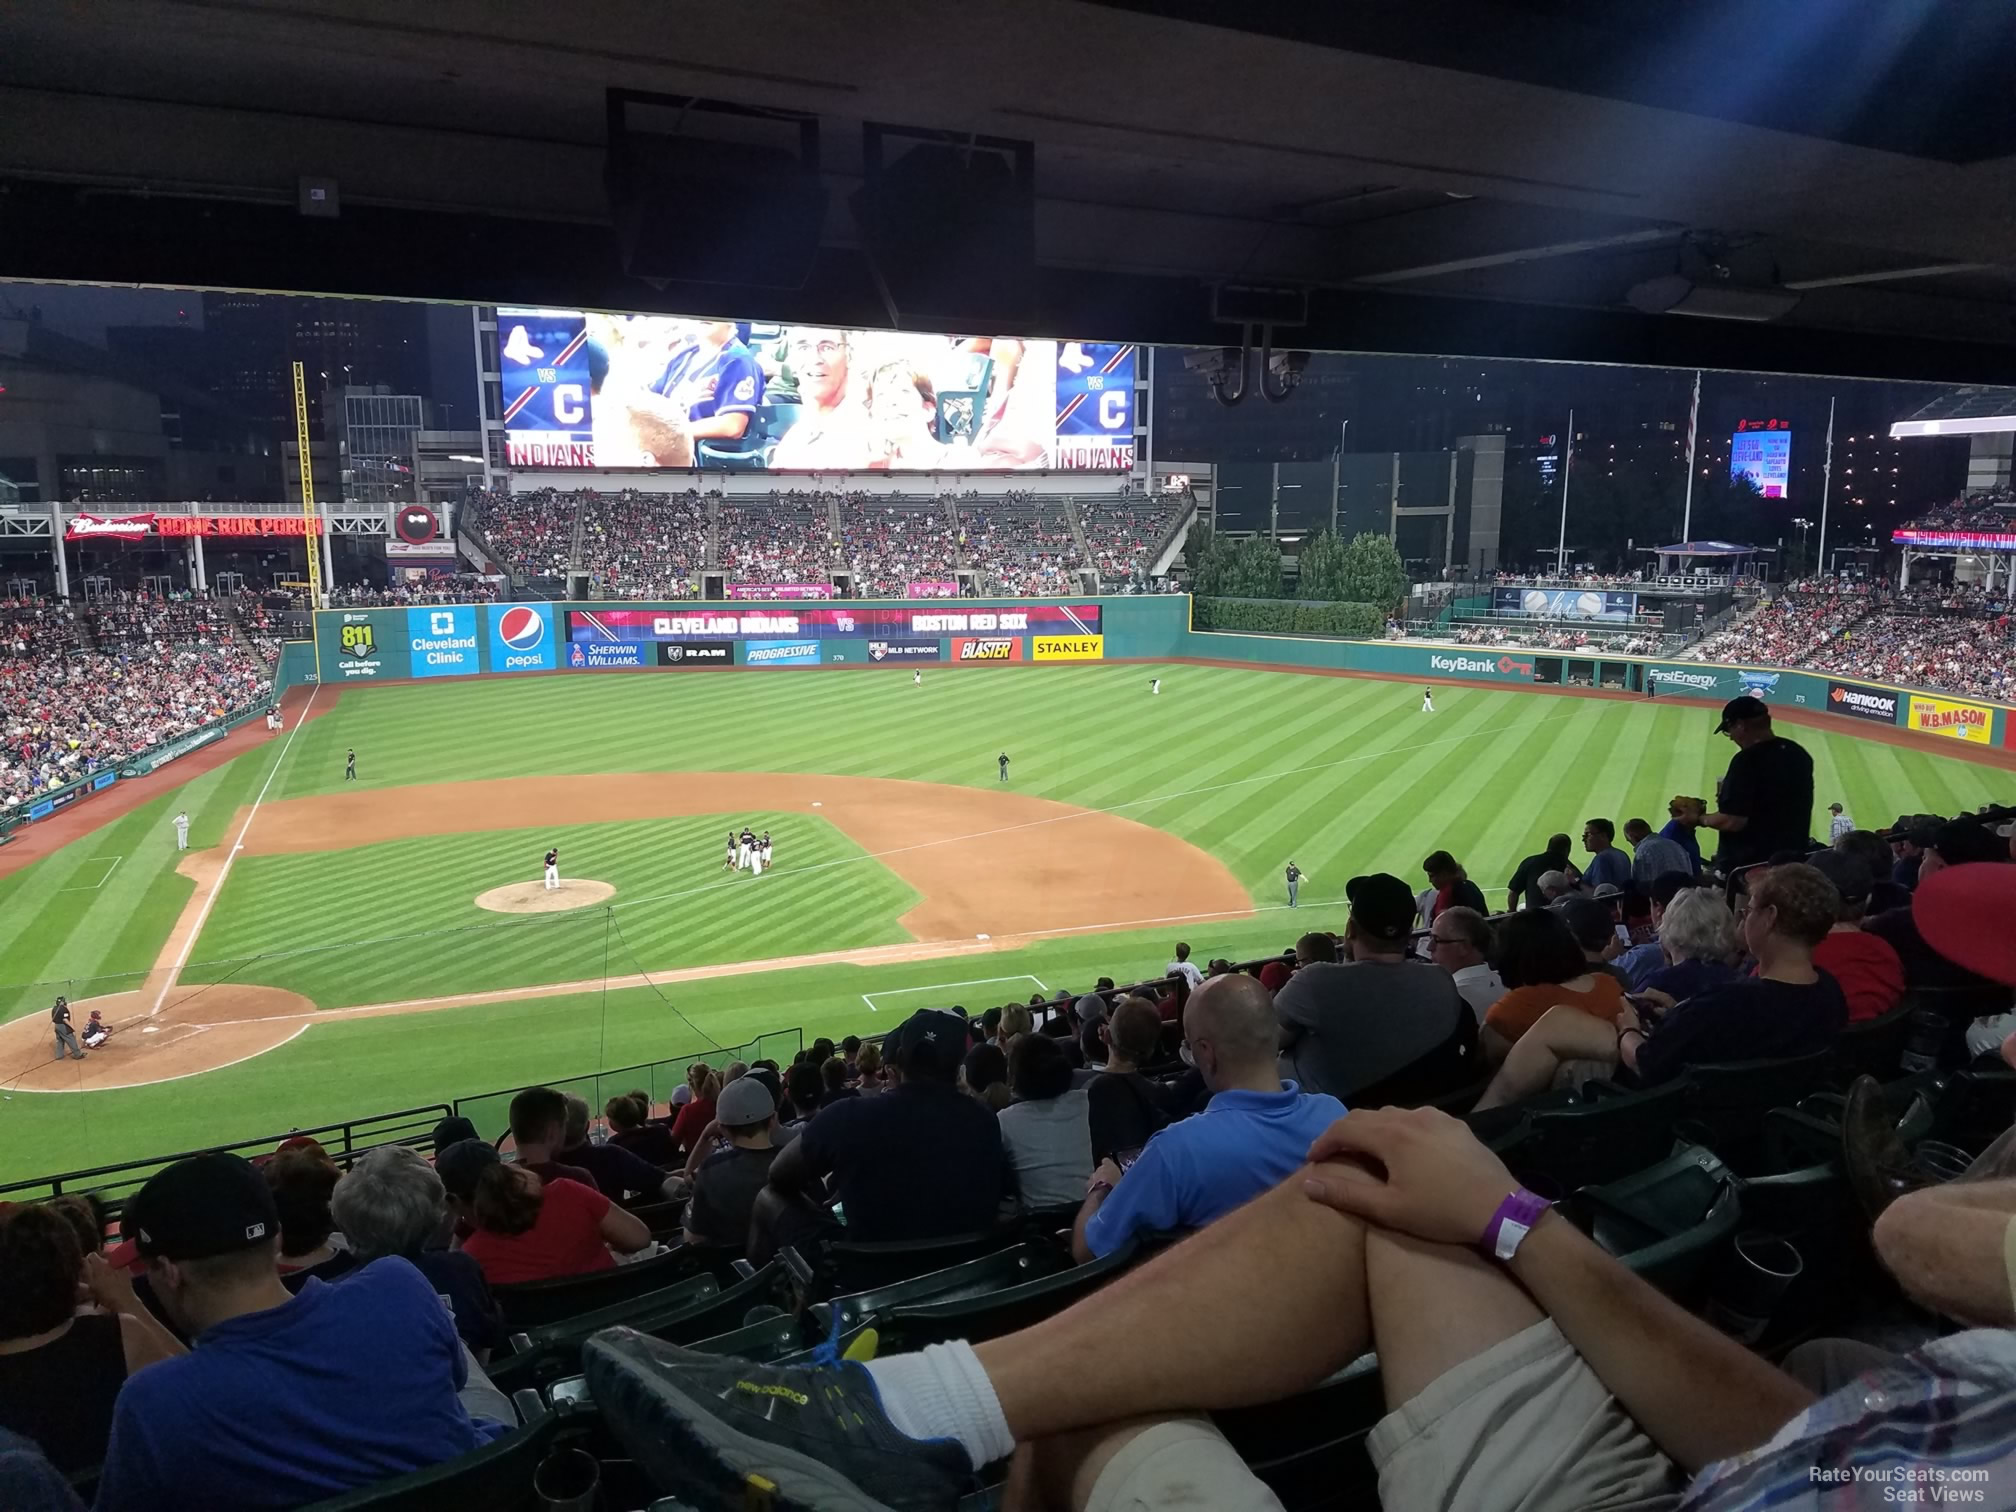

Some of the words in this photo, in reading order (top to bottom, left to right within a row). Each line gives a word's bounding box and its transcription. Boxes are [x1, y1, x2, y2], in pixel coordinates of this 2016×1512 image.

[537, 368, 557, 383] VS
[1087, 376, 1104, 390] VS
[553, 384, 584, 424] C
[1099, 391, 1125, 428] C
[508, 442, 595, 466] INDIANS
[1057, 447, 1133, 469] INDIANS
[70, 519, 149, 533] Budweiser
[158, 518, 212, 536] HOME
[217, 518, 257, 535] RUN
[654, 617, 738, 635] CLEVELAND
[740, 617, 799, 633] INDIANS
[837, 617, 855, 632] VS
[912, 615, 967, 632] BOSTON
[969, 615, 997, 631] RED
[999, 614, 1029, 630] SOX
[342, 625, 373, 647] 811
[412, 636, 476, 651] Cleveland
[588, 644, 637, 655] SHERWIN
[685, 649, 726, 657] RAM
[747, 645, 817, 661] PROGRESSIVE
[904, 646, 938, 654] NETWORK
[1037, 642, 1098, 654] STANLEY
[355, 660, 381, 668] before
[427, 652, 464, 665] Clinic
[506, 653, 543, 668] pepsi
[1431, 655, 1494, 673] KeyBank
[345, 669, 361, 677] you
[1650, 669, 1717, 687] FirstEnergy
[1851, 704, 1870, 714] driving
[1870, 709, 1893, 717] emotion
